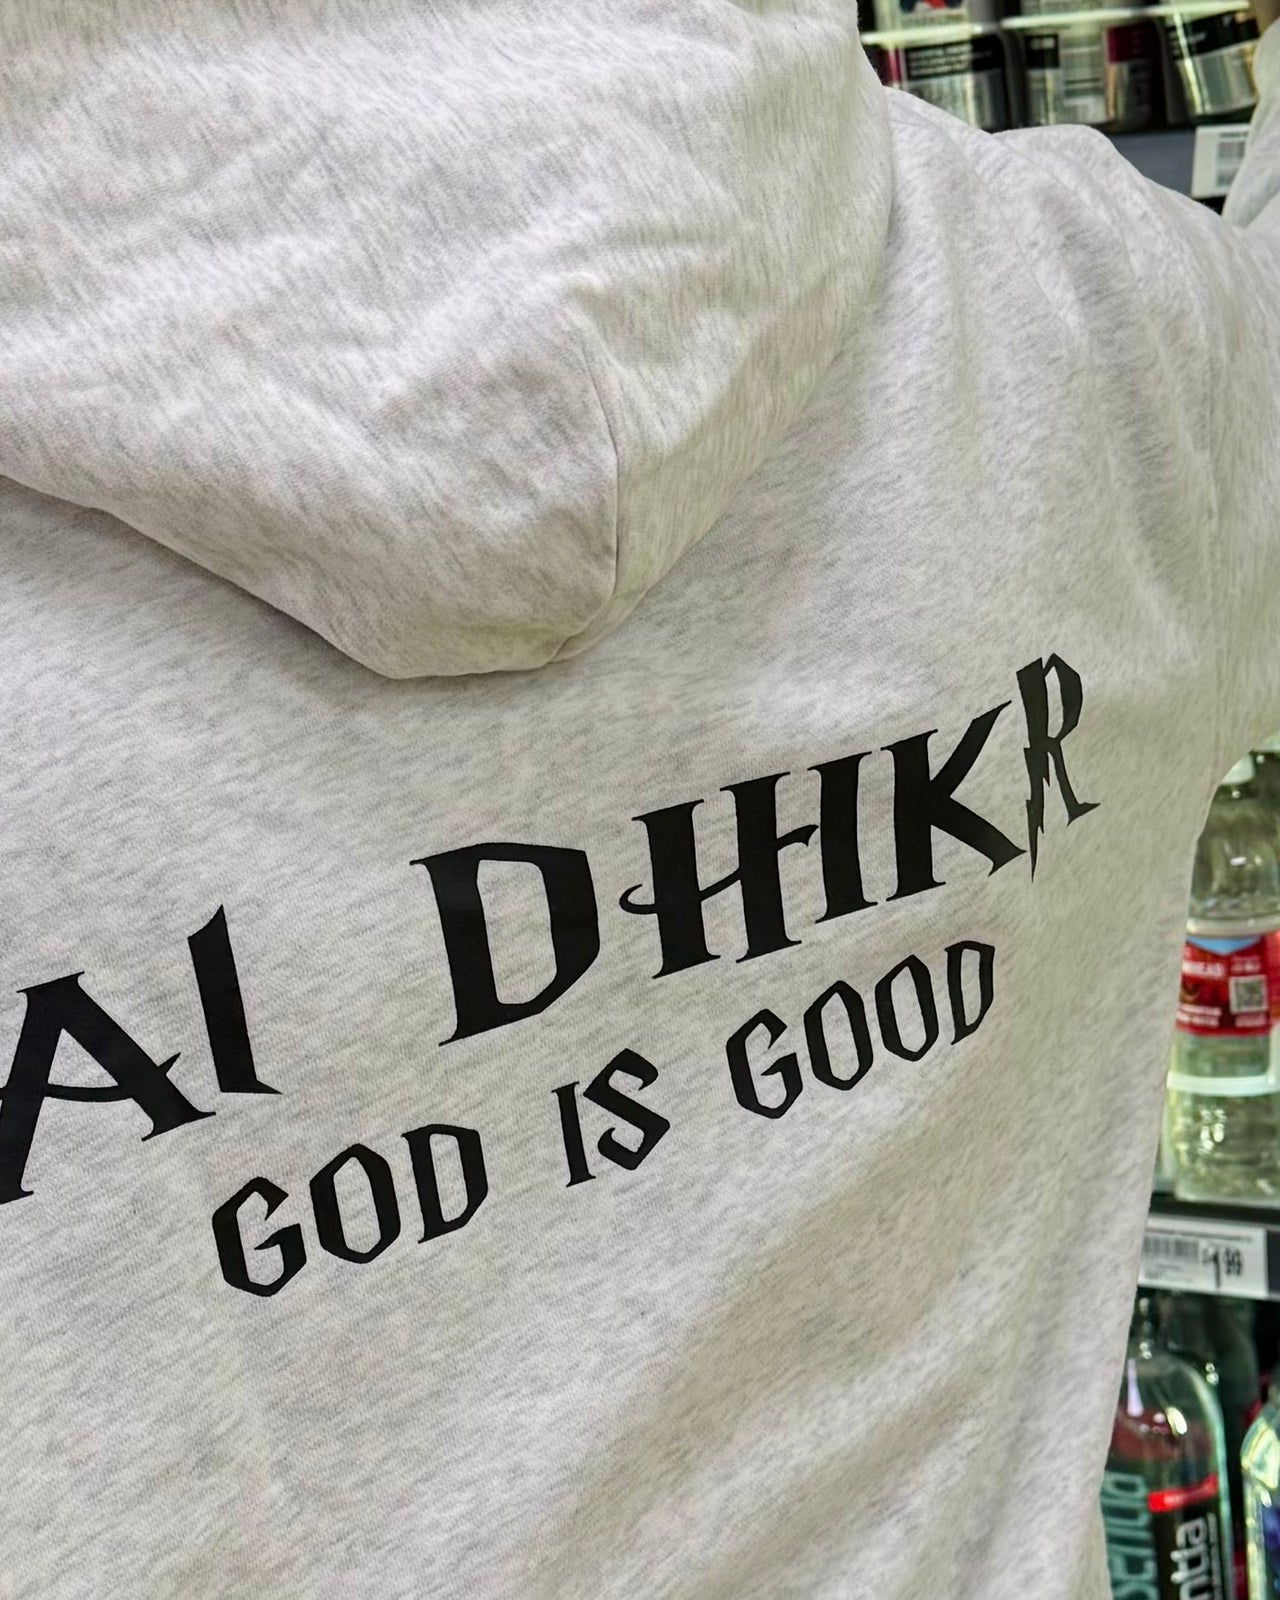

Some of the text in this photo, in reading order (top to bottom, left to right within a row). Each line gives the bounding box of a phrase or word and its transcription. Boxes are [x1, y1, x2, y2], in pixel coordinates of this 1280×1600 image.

[211, 939, 997, 1297] GOD IS GOOD
